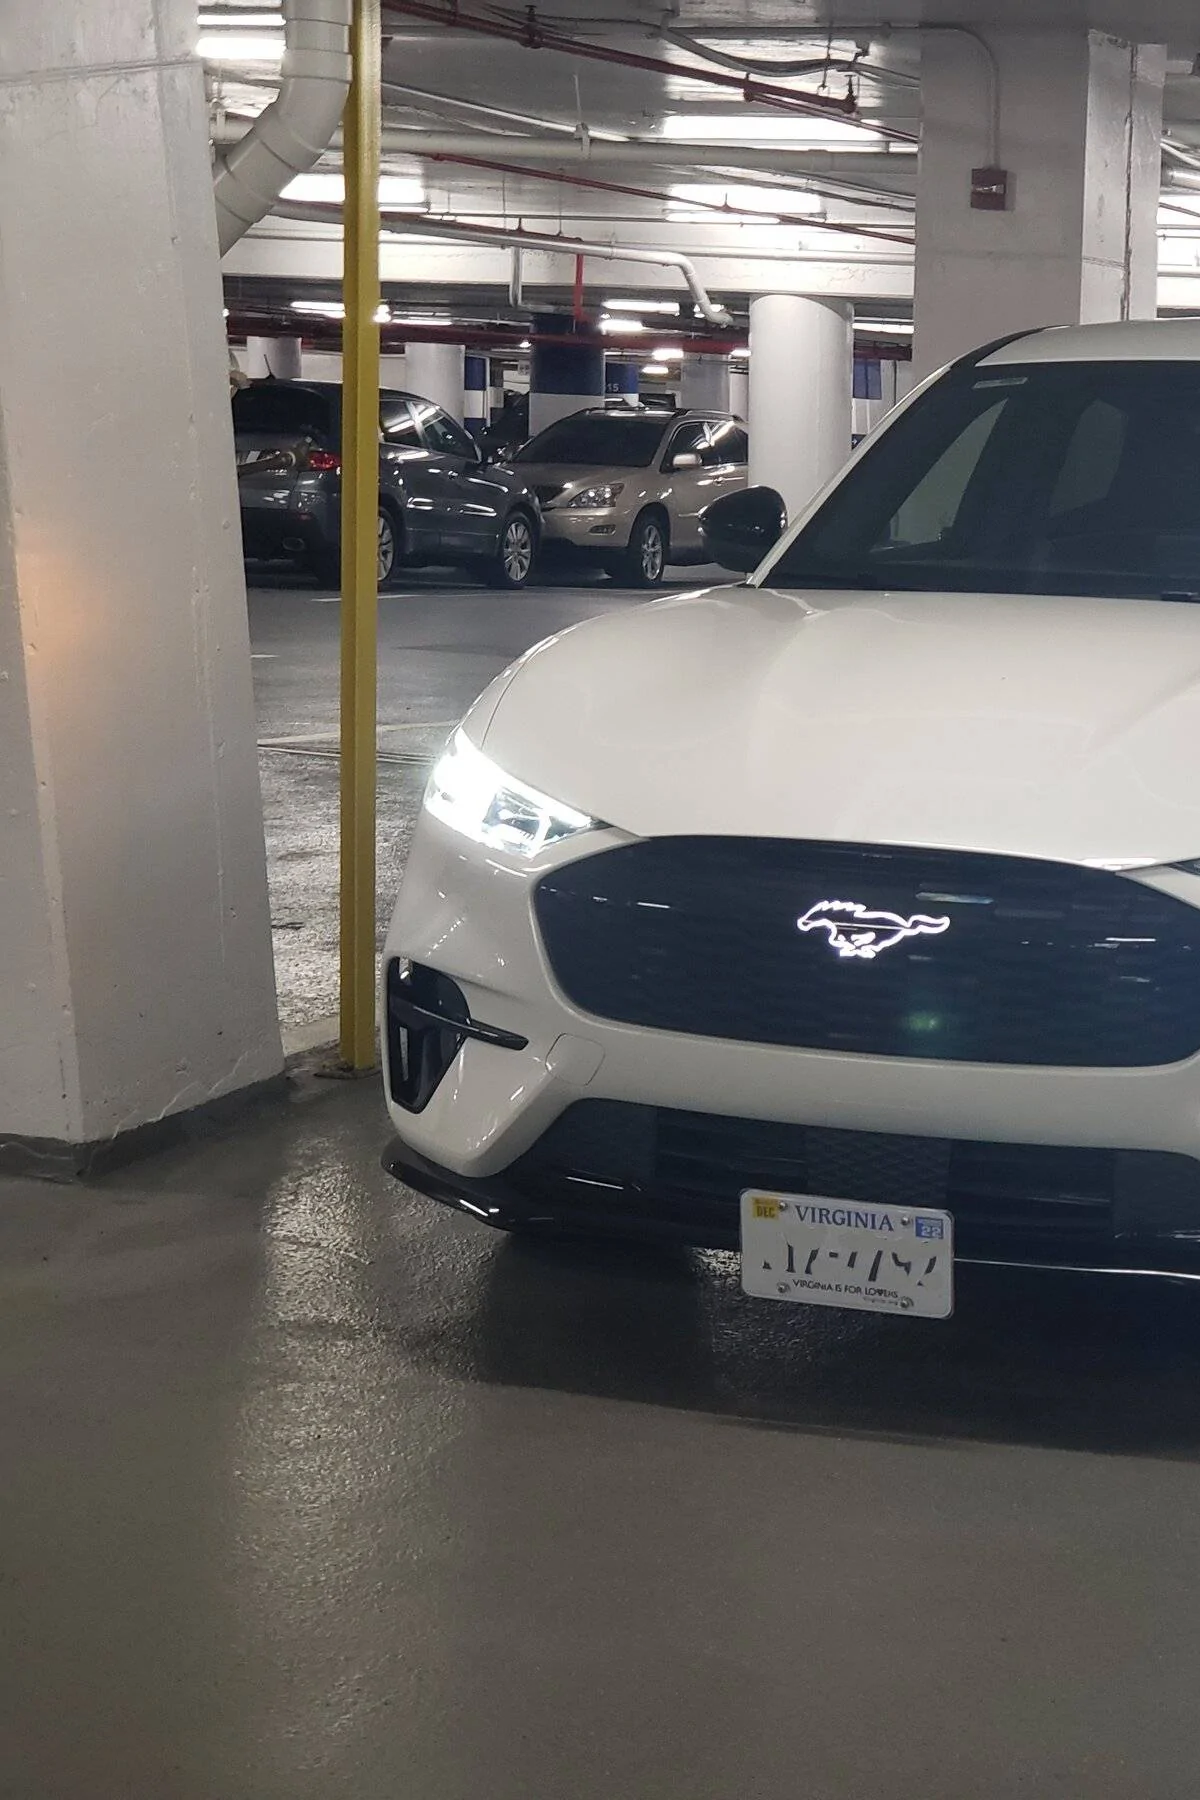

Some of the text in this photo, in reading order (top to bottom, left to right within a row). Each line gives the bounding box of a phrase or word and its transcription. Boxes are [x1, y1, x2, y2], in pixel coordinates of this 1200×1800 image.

[756, 1205, 776, 1219] DEC
[795, 1205, 894, 1232] VIRGINIA
[920, 1225, 941, 1238] 22
[792, 1279, 833, 1292] VIRGINIA
[835, 1284, 842, 1293] IS
[844, 1285, 862, 1295] FOR
